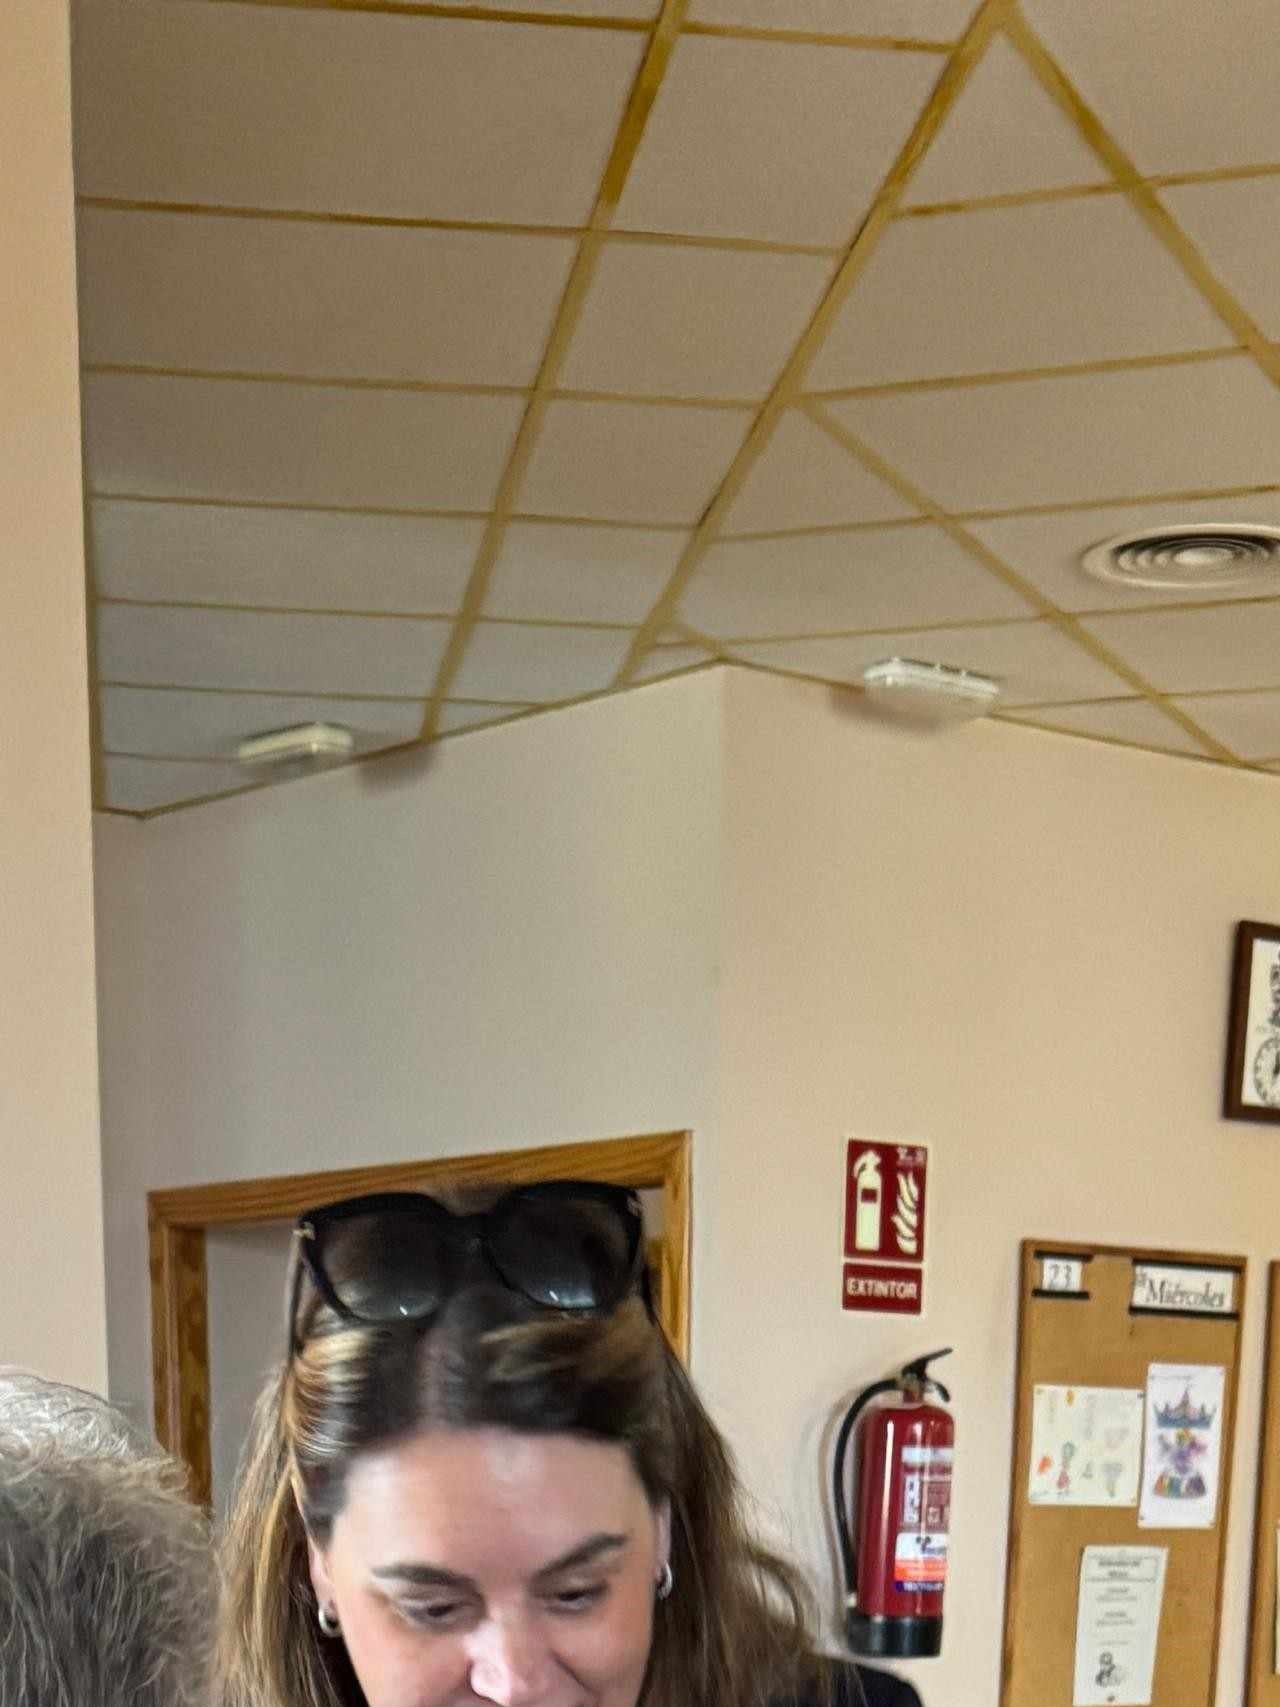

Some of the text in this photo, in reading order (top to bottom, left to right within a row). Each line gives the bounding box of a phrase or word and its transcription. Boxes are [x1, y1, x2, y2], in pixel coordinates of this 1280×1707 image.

[847, 1278, 918, 1299] EXTINTOR
[1047, 1263, 1074, 1291] 23
[1144, 1276, 1226, 1309] Miércoles
